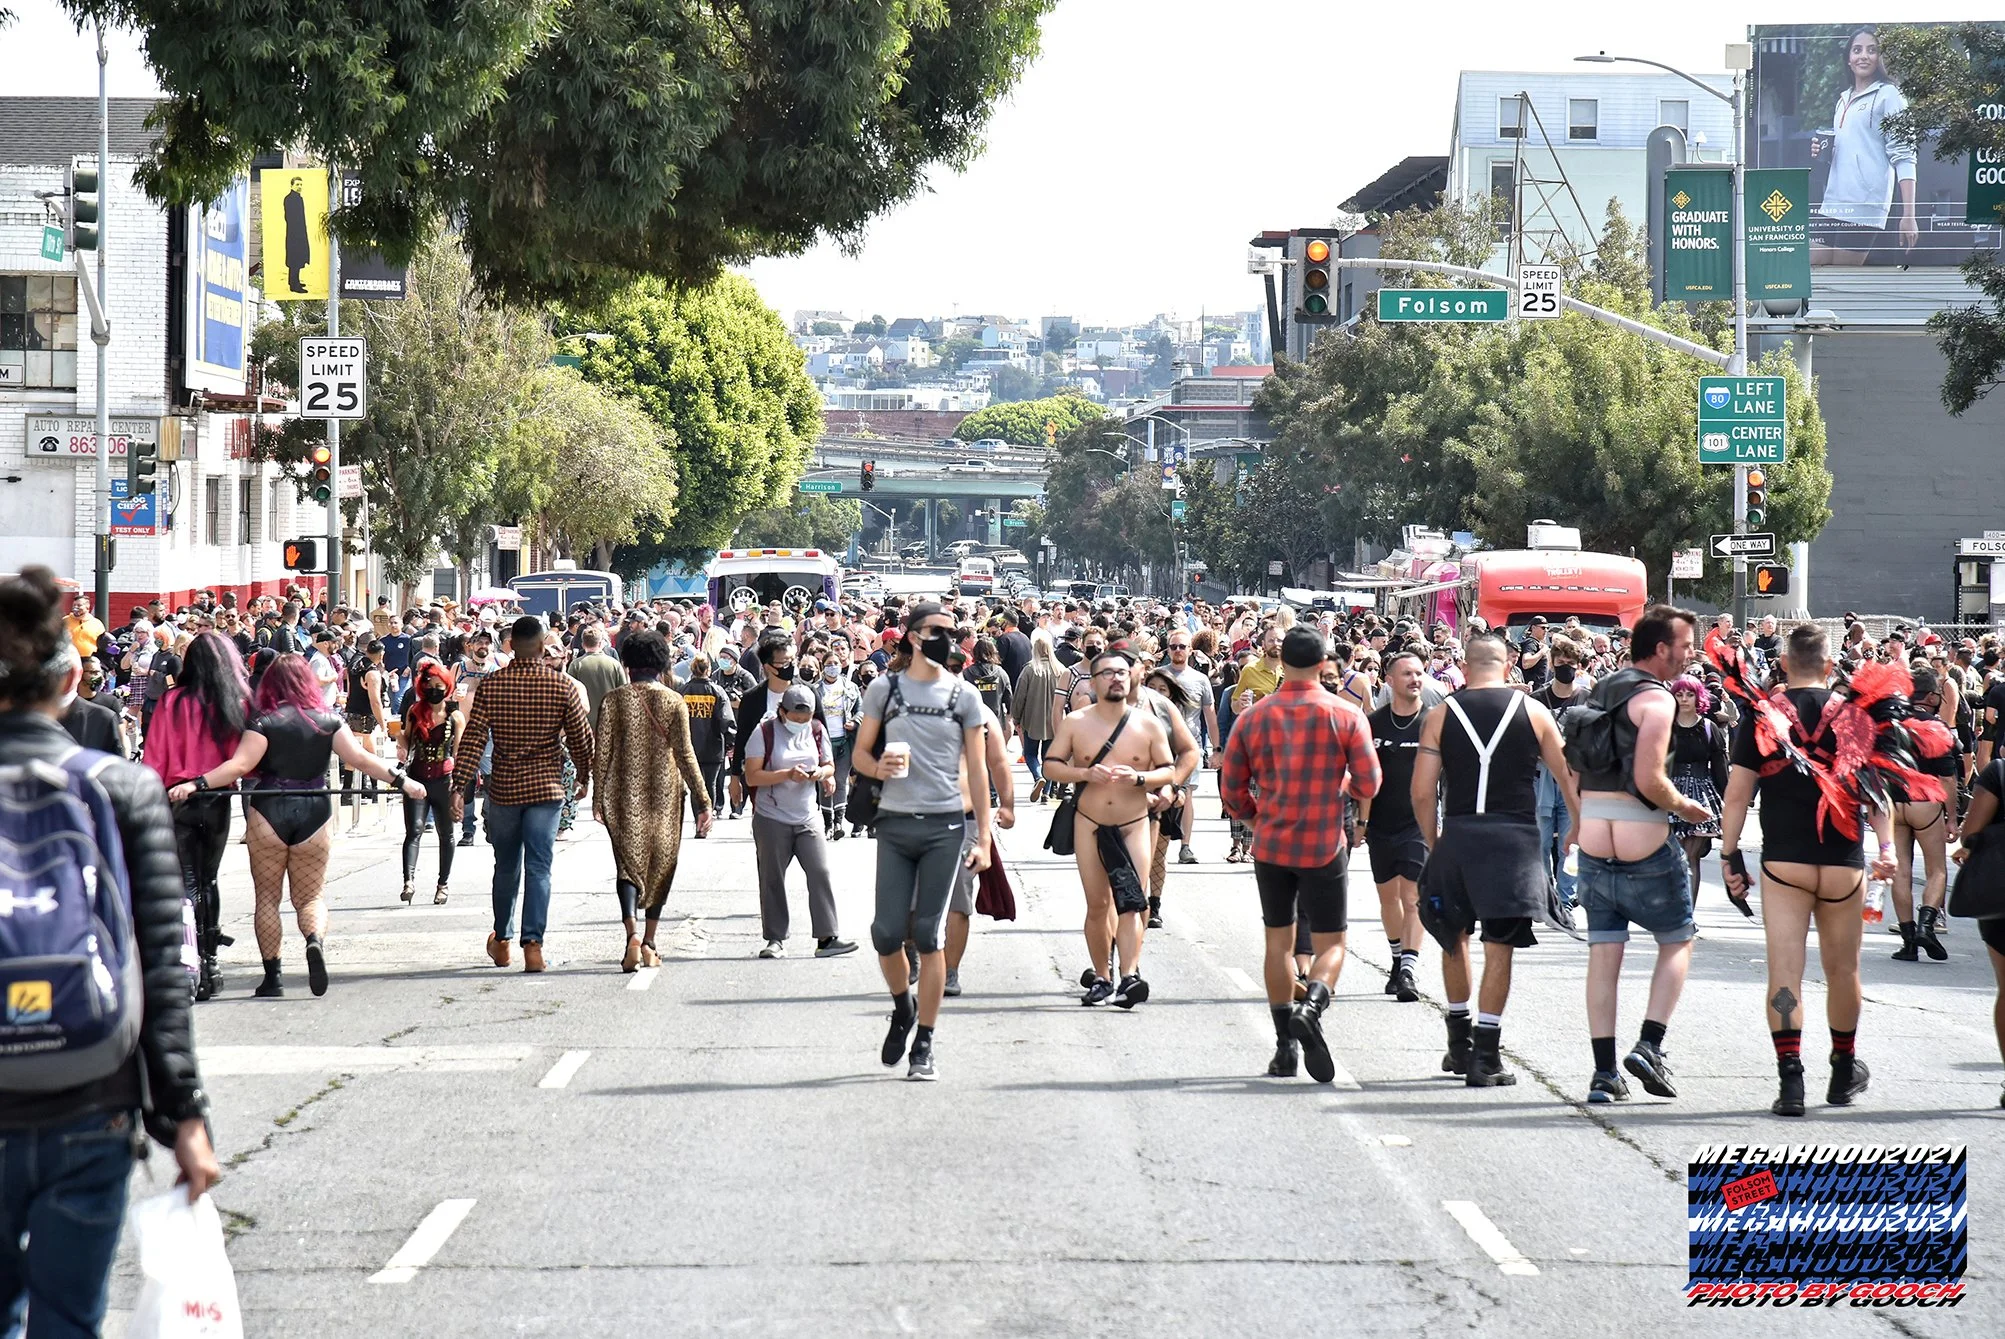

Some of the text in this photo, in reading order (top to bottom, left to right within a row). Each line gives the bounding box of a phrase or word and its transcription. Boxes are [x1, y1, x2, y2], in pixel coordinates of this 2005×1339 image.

[1671, 211, 1728, 224] GRADUATE
[1671, 224, 1702, 237] WITH
[1748, 225, 1805, 235] UNIVERSITY OF
[1748, 232, 1805, 242] SAN FRANCISCO
[1671, 238, 1719, 250] HONORS.
[1523, 271, 1558, 281] SPEED
[1525, 282, 1553, 291] LIMIT
[1399, 297, 1488, 314] Folsom
[1523, 294, 1556, 312] 25
[306, 346, 359, 358] SPEED
[311, 364, 353, 376] LIMIT
[1736, 383, 1773, 396] LEFT
[307, 383, 358, 411] 25
[1711, 394, 1724, 404] 80
[1734, 401, 1776, 414] LANE
[34, 420, 152, 434] AUTO REPAI CENTER
[1731, 426, 1782, 440] CENTER
[1708, 437, 1724, 449] 101
[1736, 445, 1777, 458] LANE
[1730, 541, 1768, 551] ONE WAY
